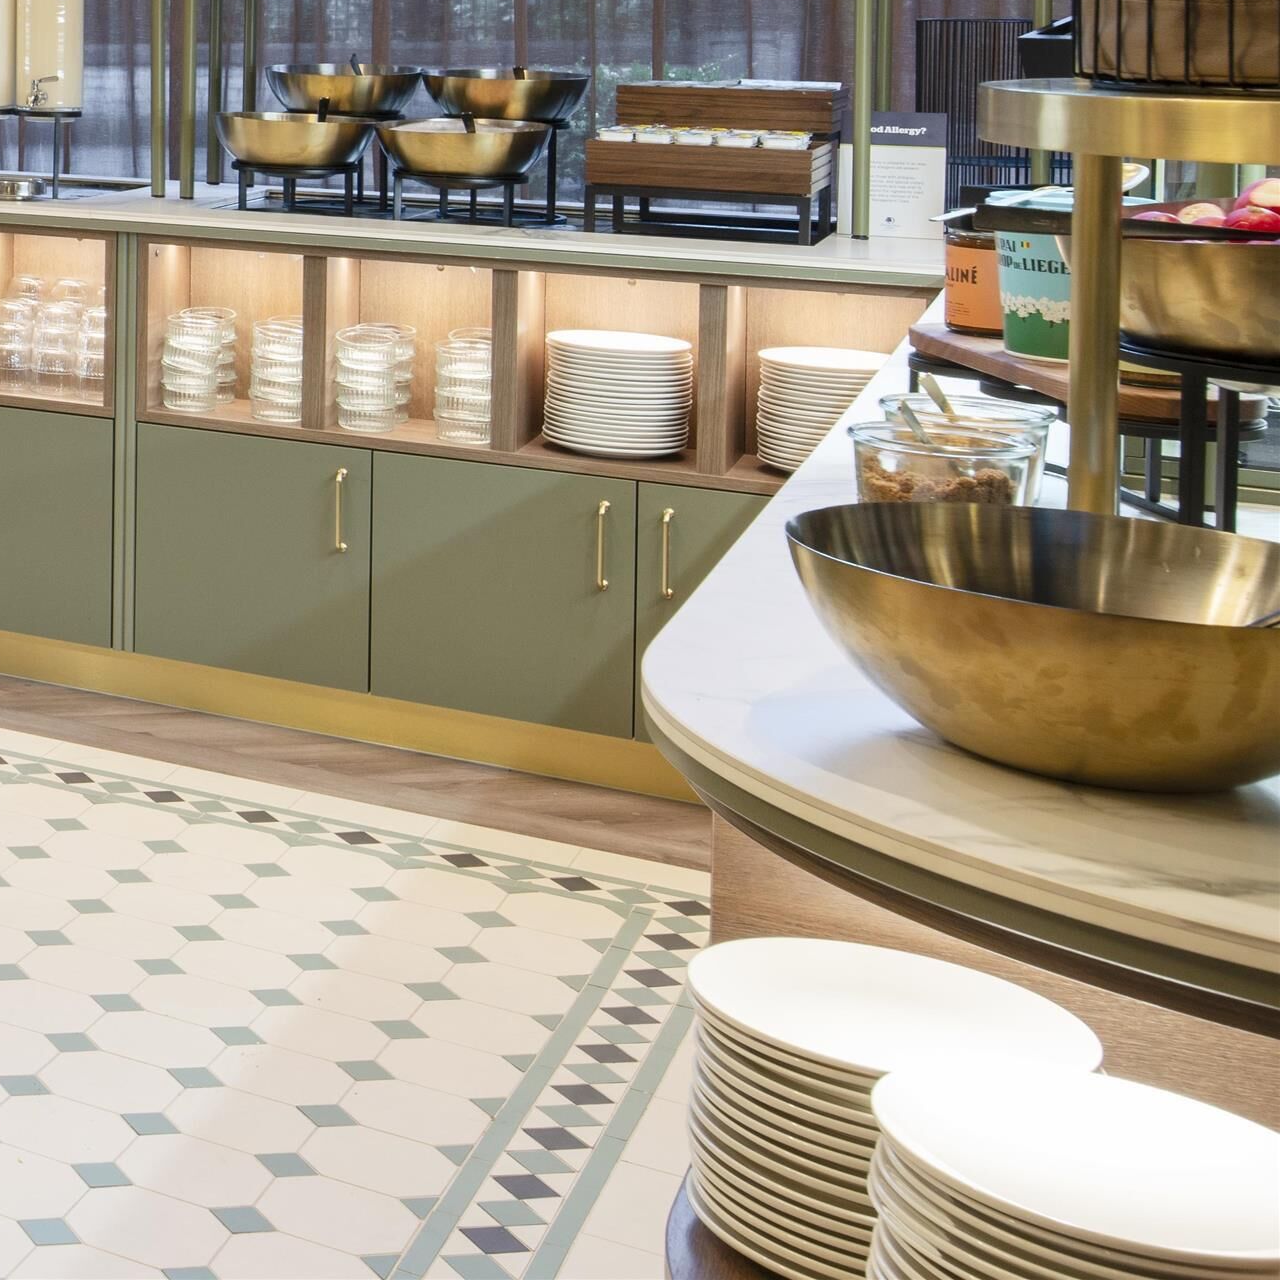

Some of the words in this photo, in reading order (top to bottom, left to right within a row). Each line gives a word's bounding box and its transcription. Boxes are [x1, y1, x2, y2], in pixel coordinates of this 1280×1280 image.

[885, 126, 927, 136] Allergy?
[1000, 238, 1016, 253] RAI
[945, 266, 977, 284] ALINÉ
